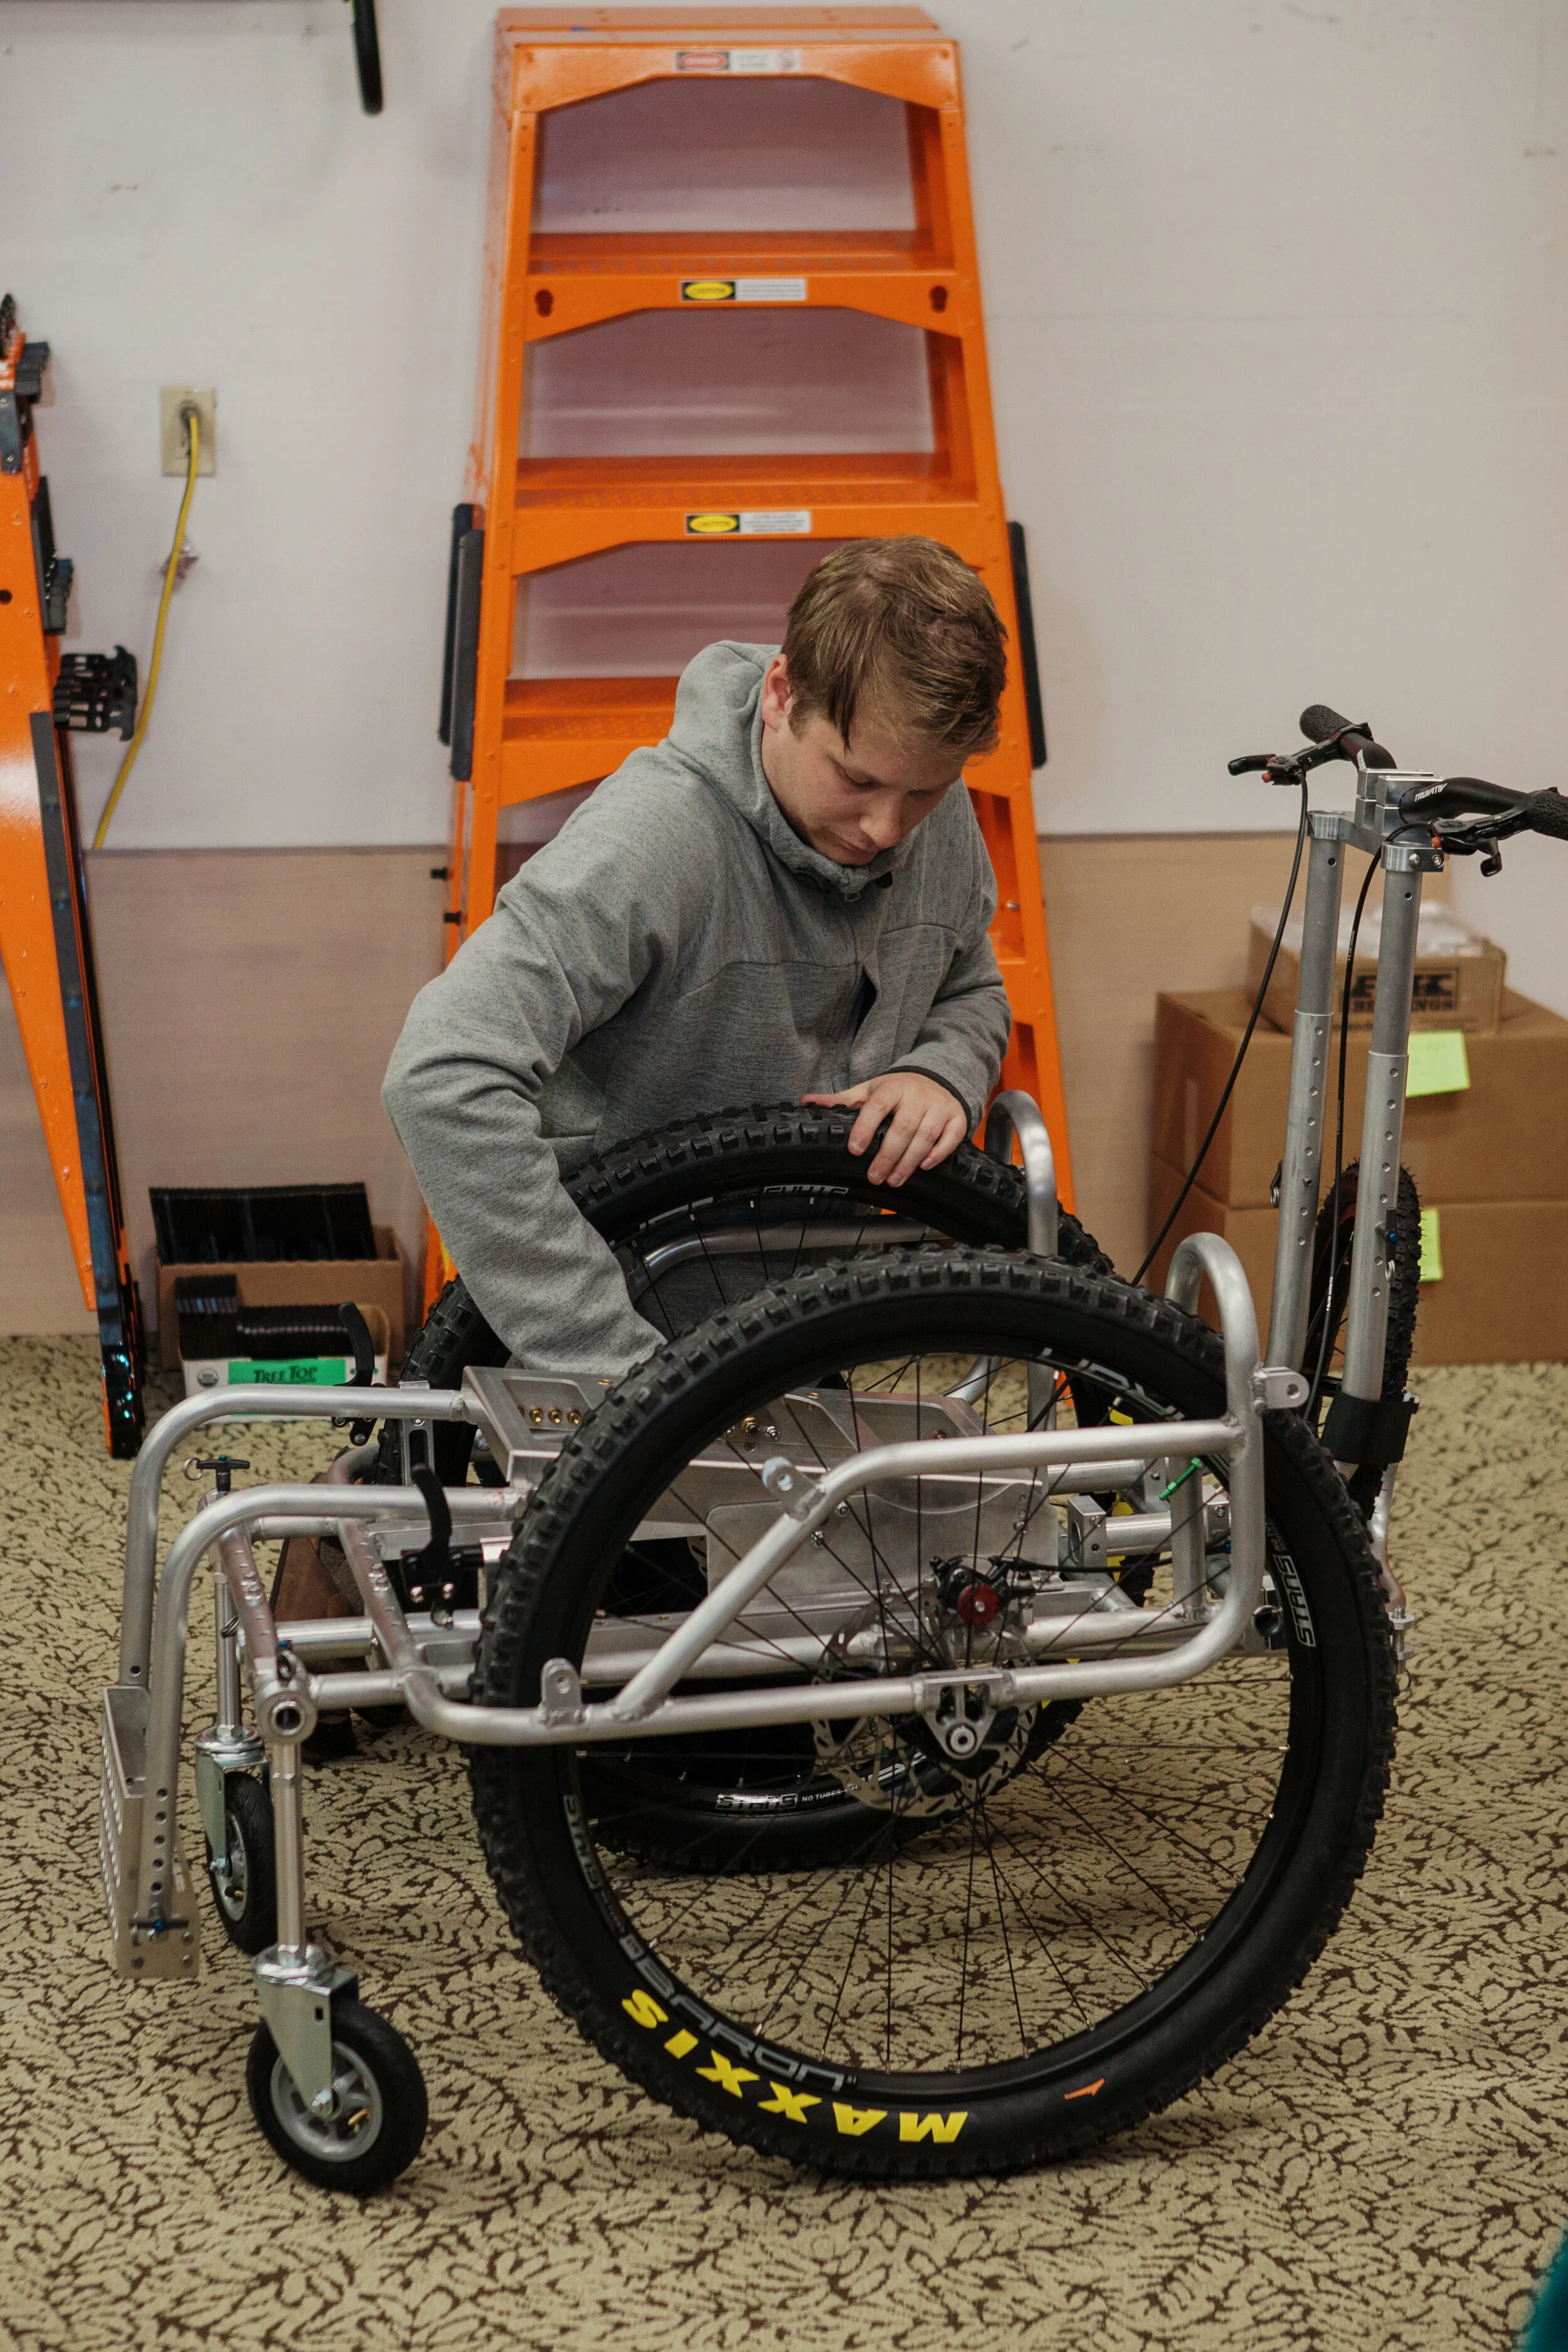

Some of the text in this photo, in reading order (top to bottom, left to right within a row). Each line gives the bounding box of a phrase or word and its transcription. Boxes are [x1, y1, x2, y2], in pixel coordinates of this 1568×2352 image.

[289, 1365, 317, 1380] TOP
[802, 1794, 813, 1803] NO
[622, 1989, 968, 2144] MAXXIS
